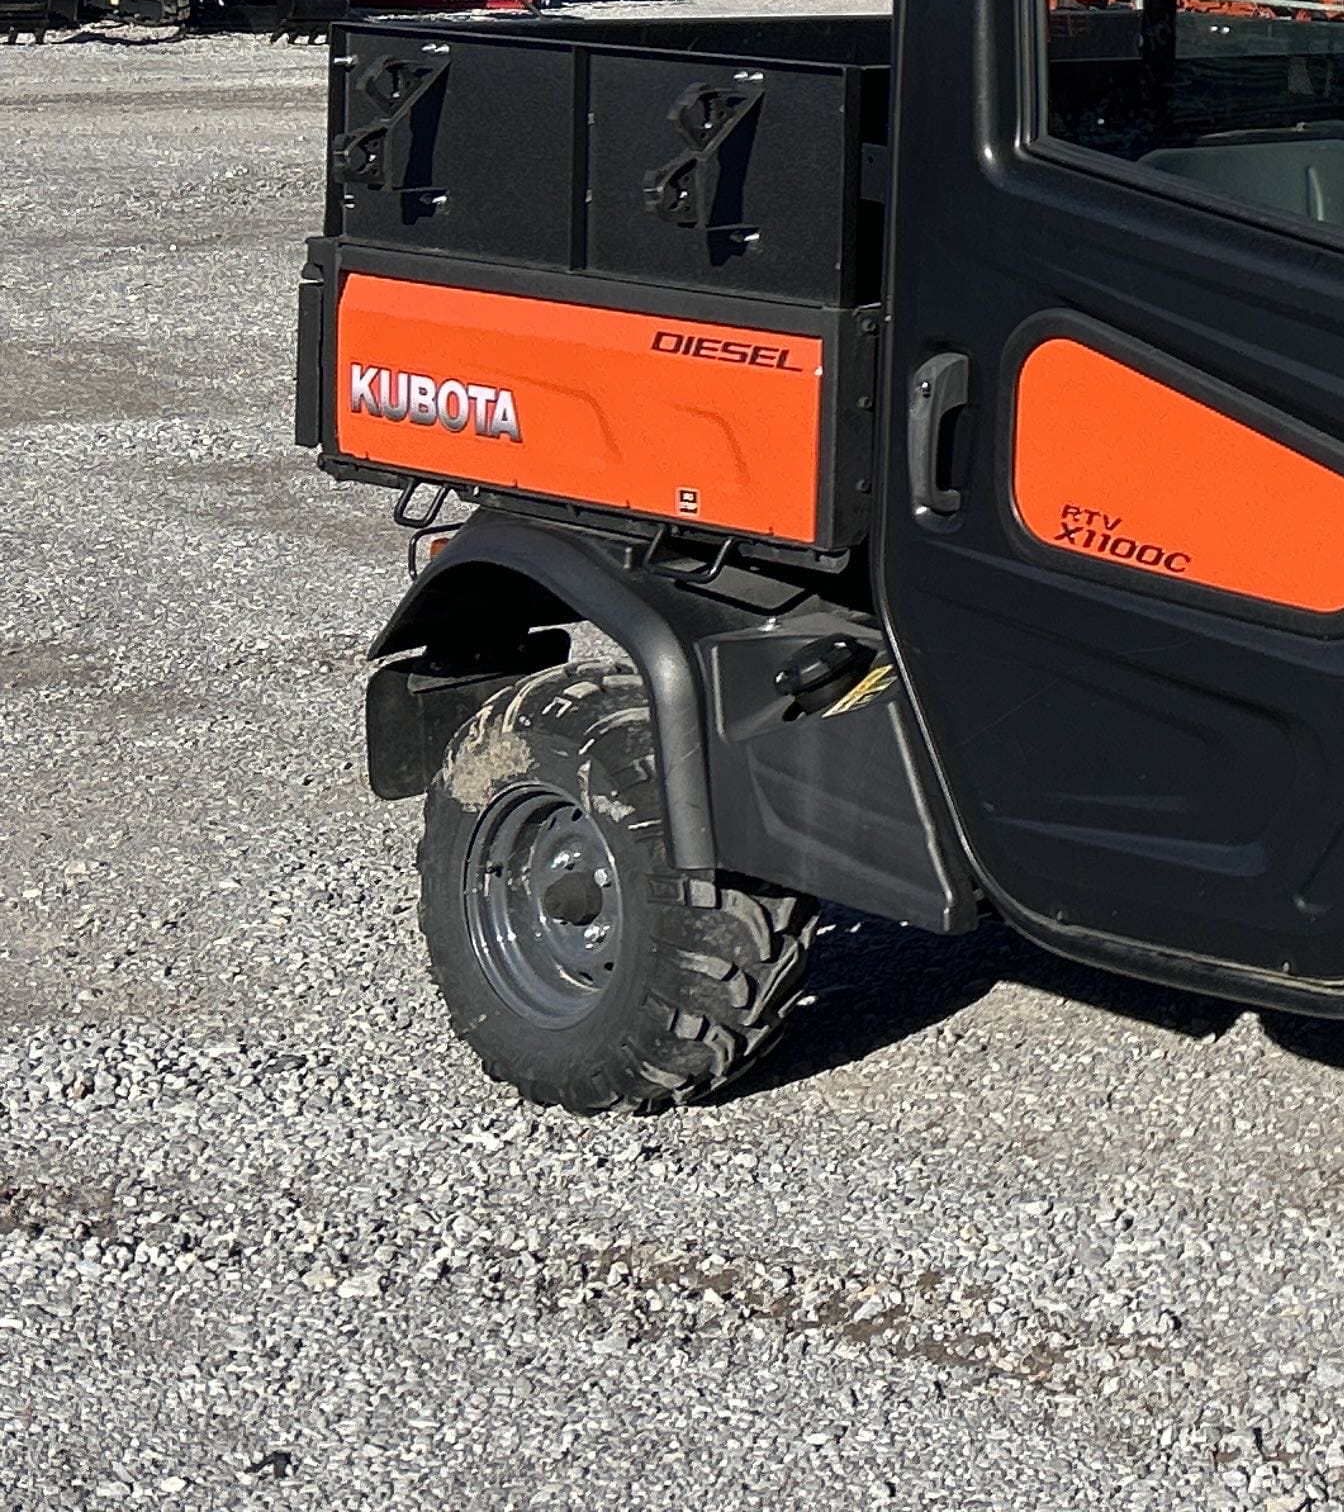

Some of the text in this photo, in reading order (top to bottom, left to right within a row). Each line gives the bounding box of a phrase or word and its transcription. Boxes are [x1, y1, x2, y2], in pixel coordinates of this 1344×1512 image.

[651, 331, 804, 372] DIESEL
[351, 362, 523, 443] KUBOTA
[1061, 504, 1122, 531] RTV
[1053, 522, 1192, 573] X1100C
